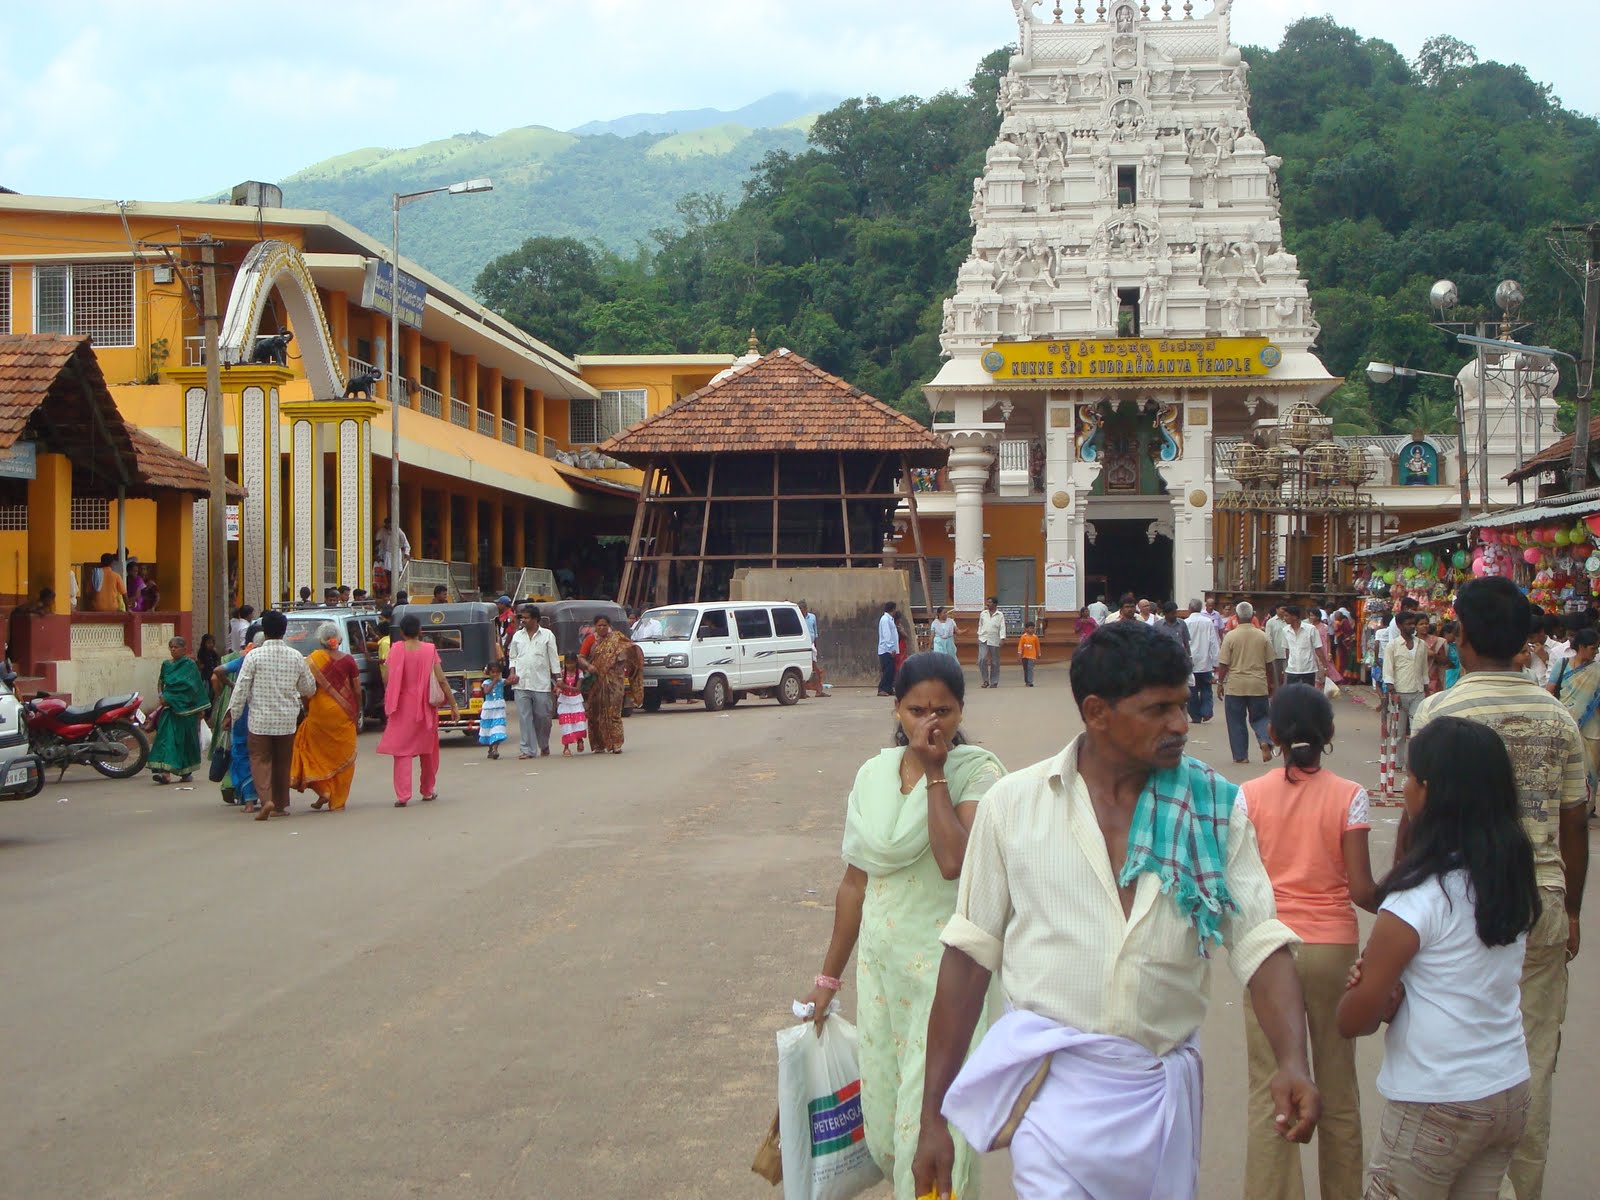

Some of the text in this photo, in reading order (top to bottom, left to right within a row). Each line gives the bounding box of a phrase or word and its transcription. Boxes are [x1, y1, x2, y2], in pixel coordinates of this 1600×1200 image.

[1012, 357, 1251, 375] KUKKE SRI SUBRAHMANYA TEMPLE
